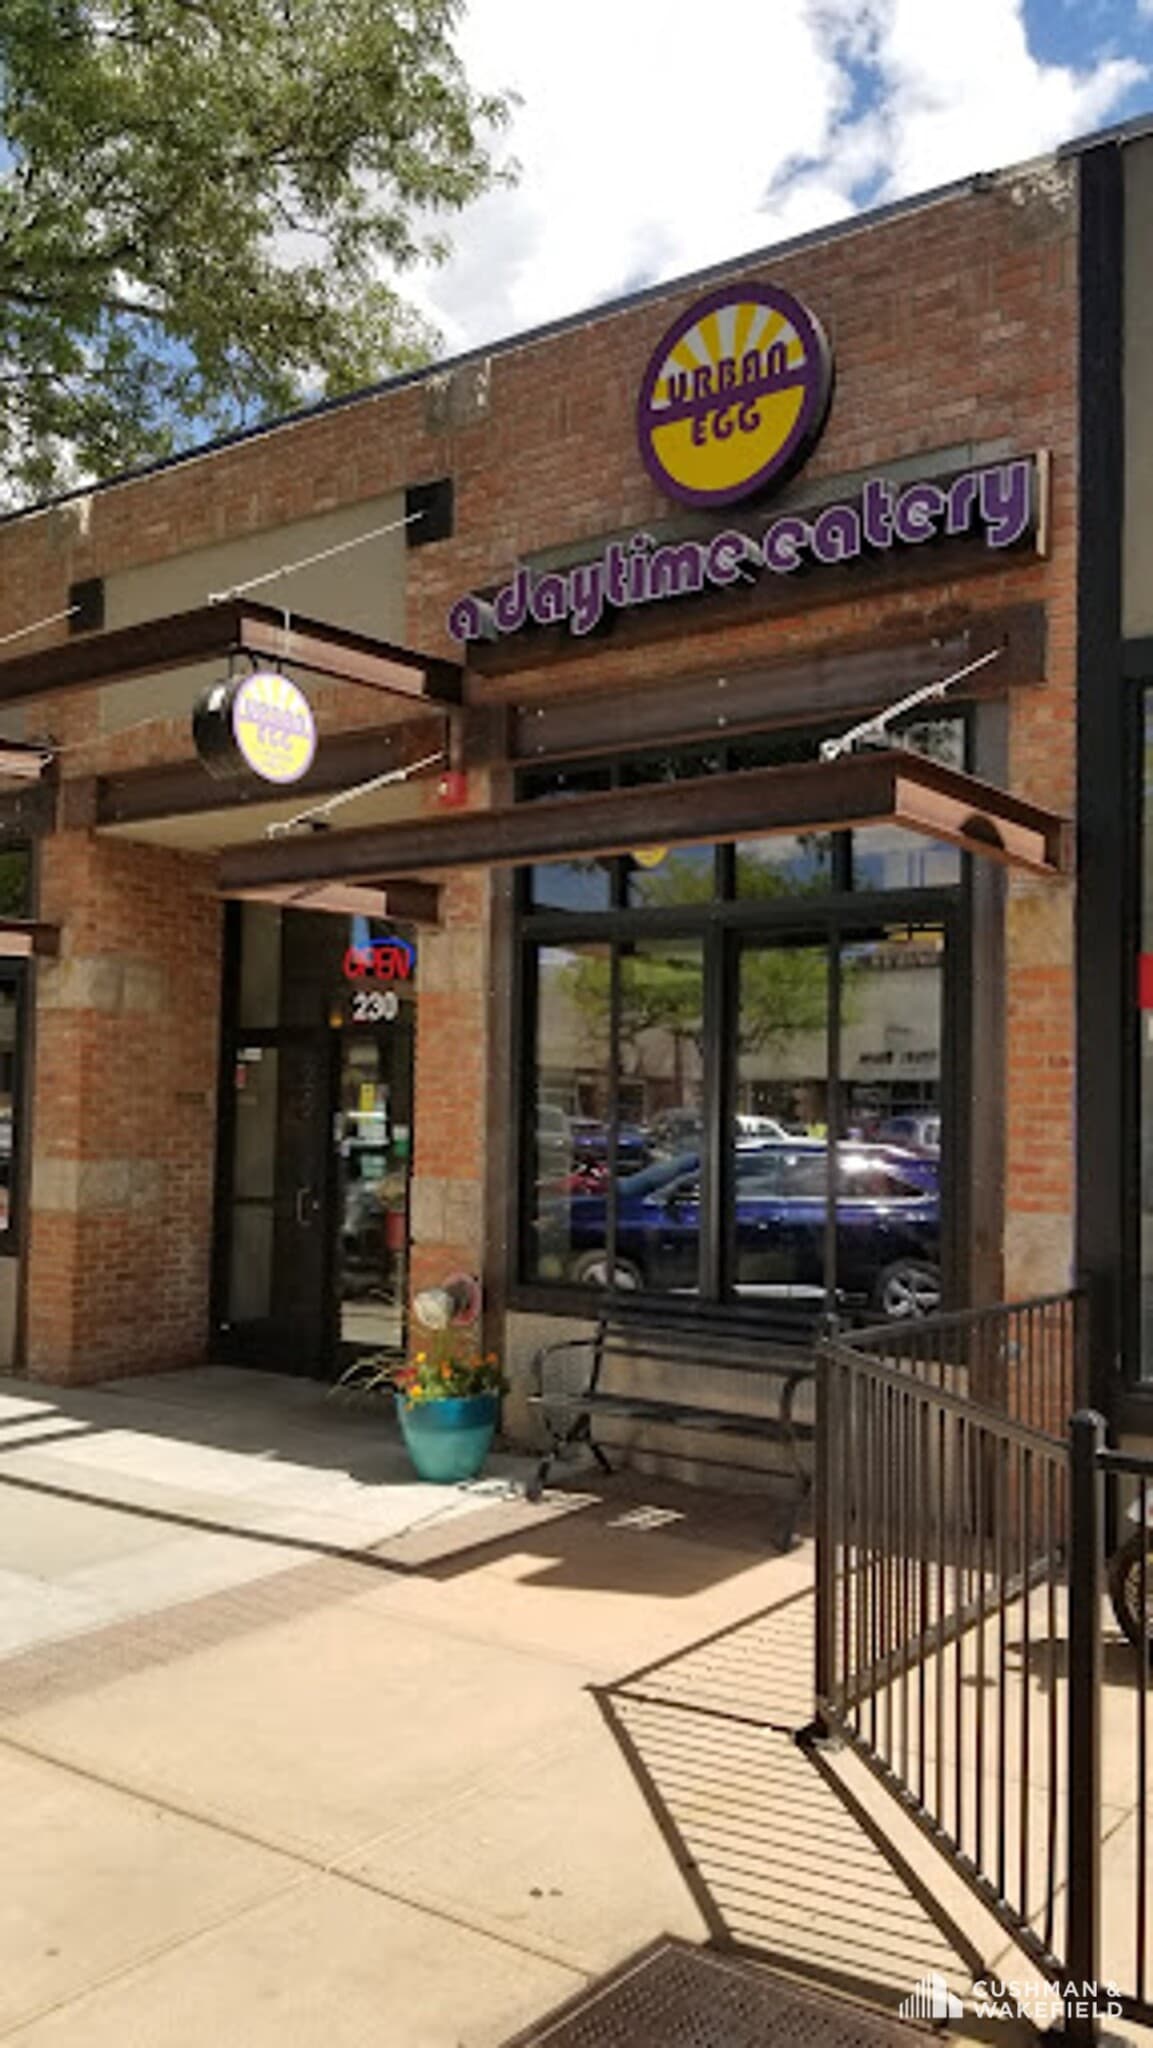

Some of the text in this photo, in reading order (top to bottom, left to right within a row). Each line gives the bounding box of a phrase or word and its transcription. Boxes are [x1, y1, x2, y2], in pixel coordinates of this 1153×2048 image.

[667, 340, 788, 402] URBAN
[691, 399, 761, 447] EGG
[448, 460, 1030, 641] a daytime eatery
[244, 699, 307, 735] URBAN
[343, 945, 411, 980] OPEN
[352, 990, 399, 1021] 230
